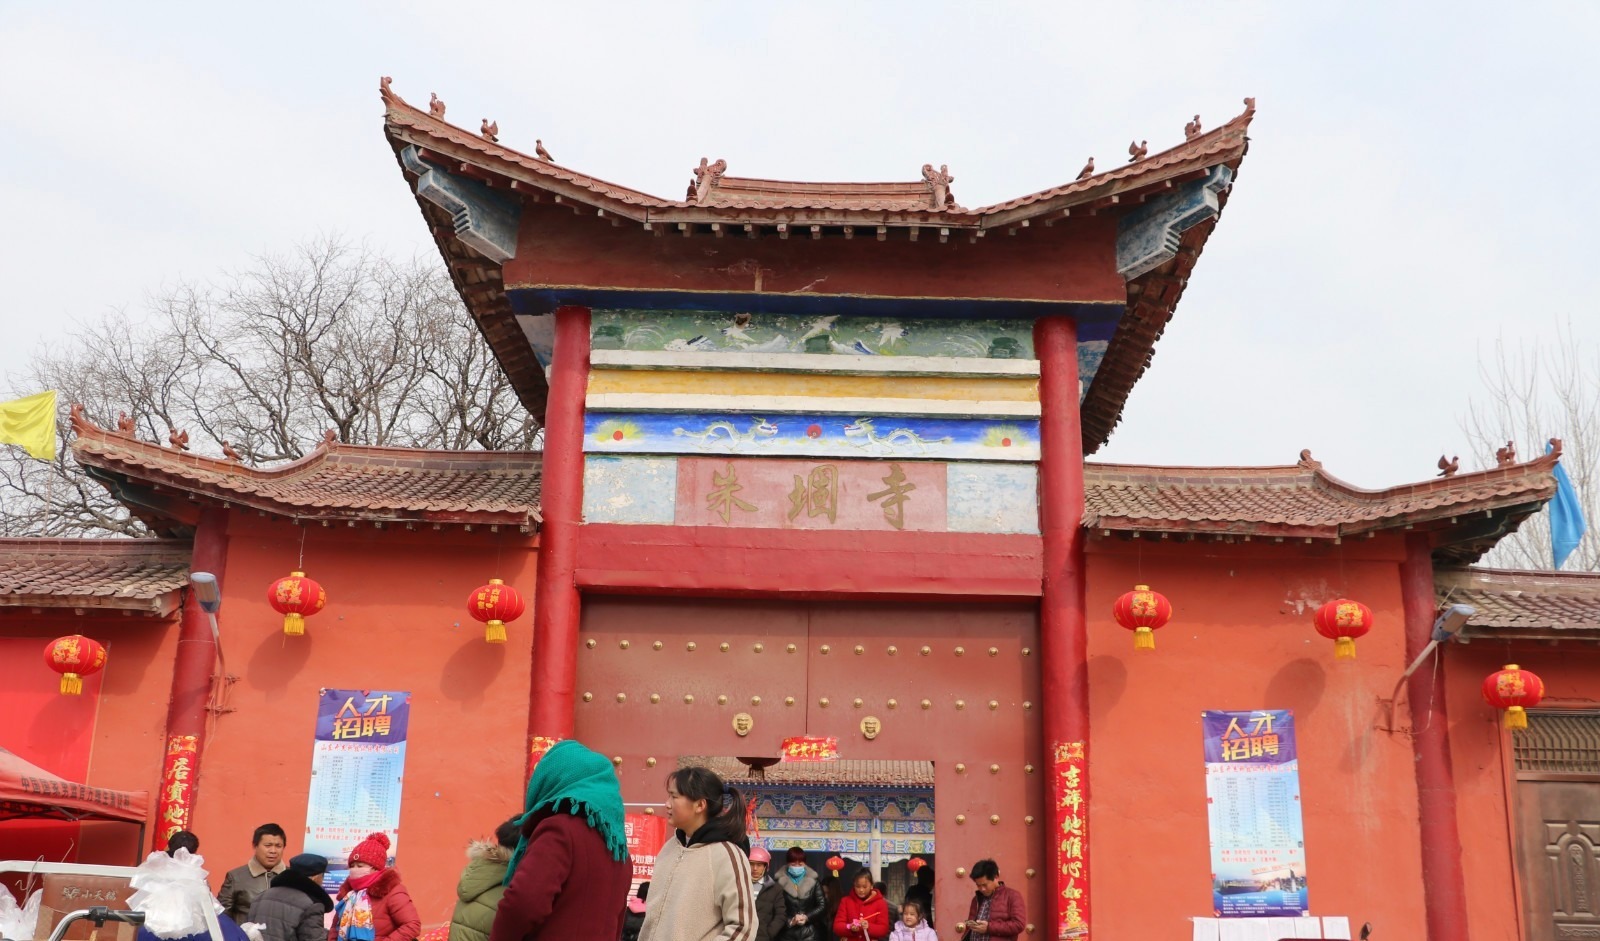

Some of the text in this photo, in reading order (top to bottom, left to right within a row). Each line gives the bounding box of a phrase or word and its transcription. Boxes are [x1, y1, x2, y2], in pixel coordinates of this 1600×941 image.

[335, 694, 393, 719] 人才
[332, 715, 392, 740] 招聘
[1222, 714, 1276, 740] 人才
[1222, 734, 1279, 761] 招聘
